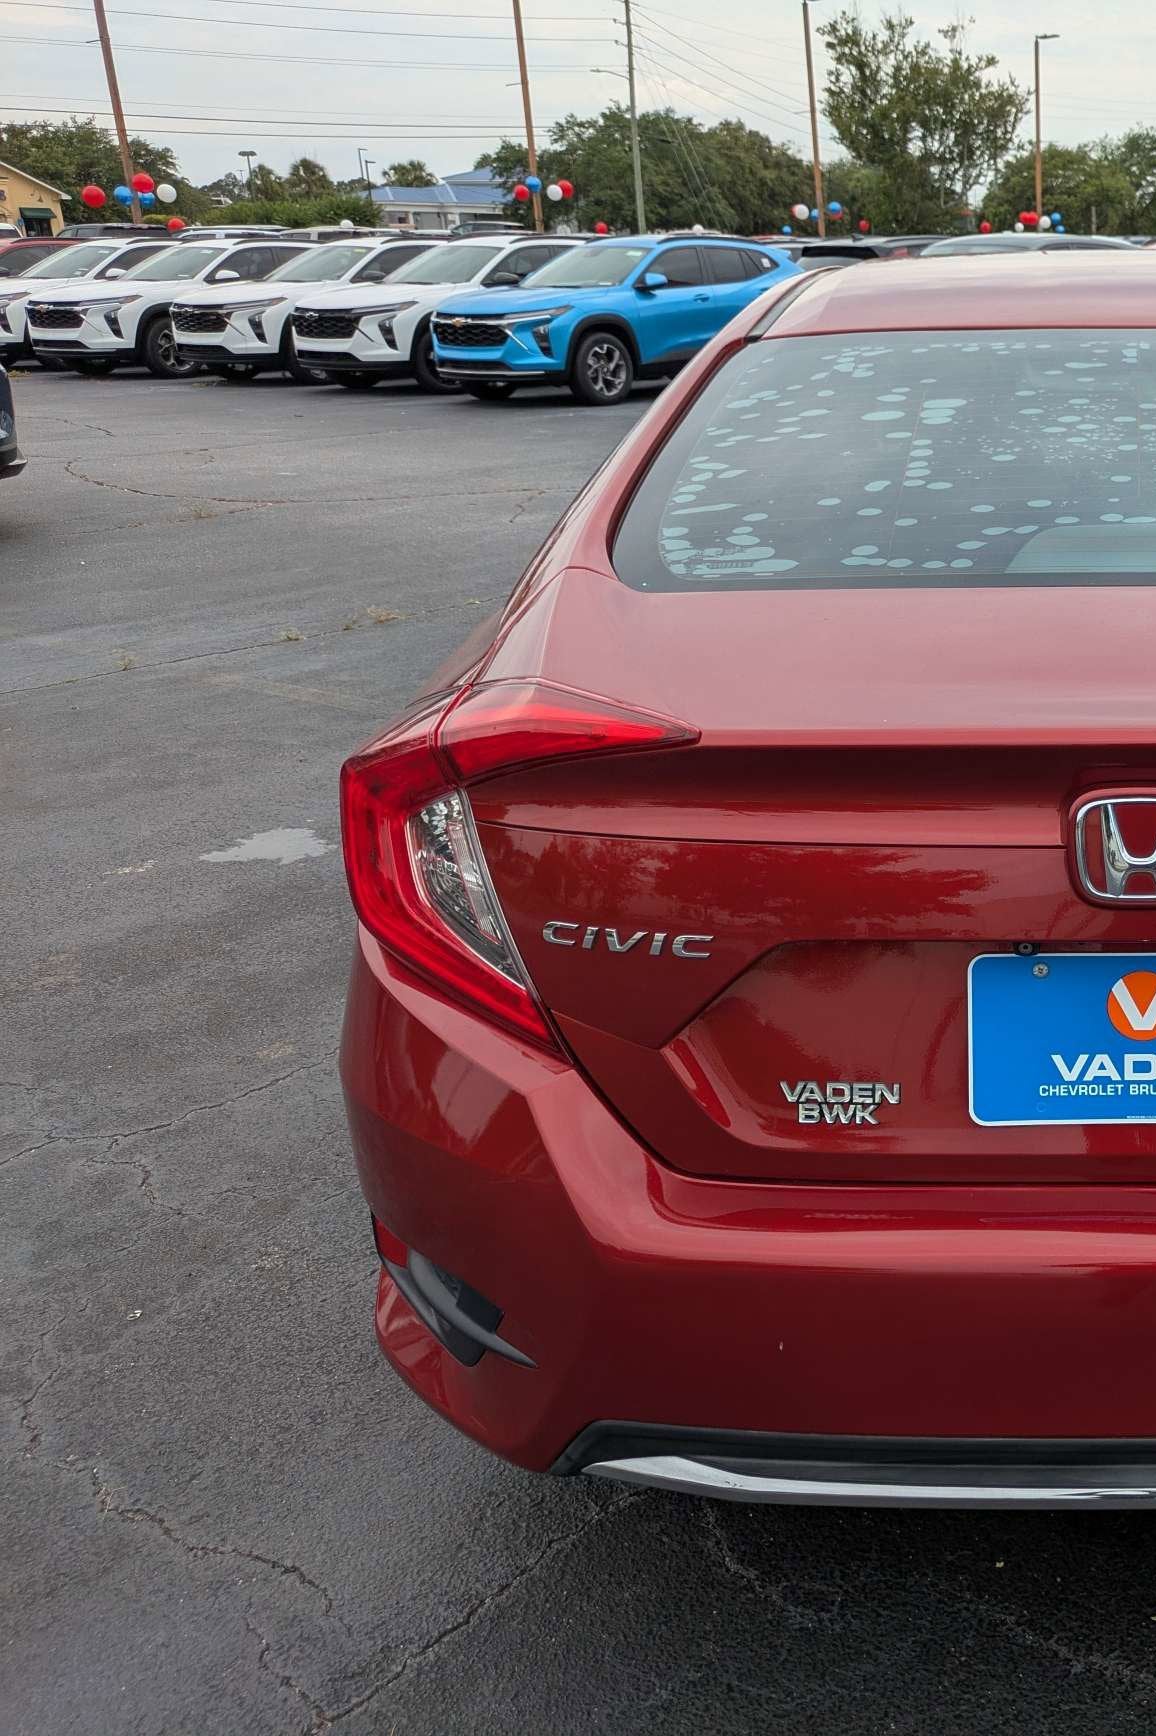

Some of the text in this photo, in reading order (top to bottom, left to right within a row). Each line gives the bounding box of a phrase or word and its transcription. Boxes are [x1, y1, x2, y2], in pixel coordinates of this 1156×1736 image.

[542, 921, 715, 959] CIVIC
[779, 1081, 901, 1104] VADEN
[1039, 1084, 1124, 1097] CHEVROLET
[798, 1103, 880, 1125] BWK
